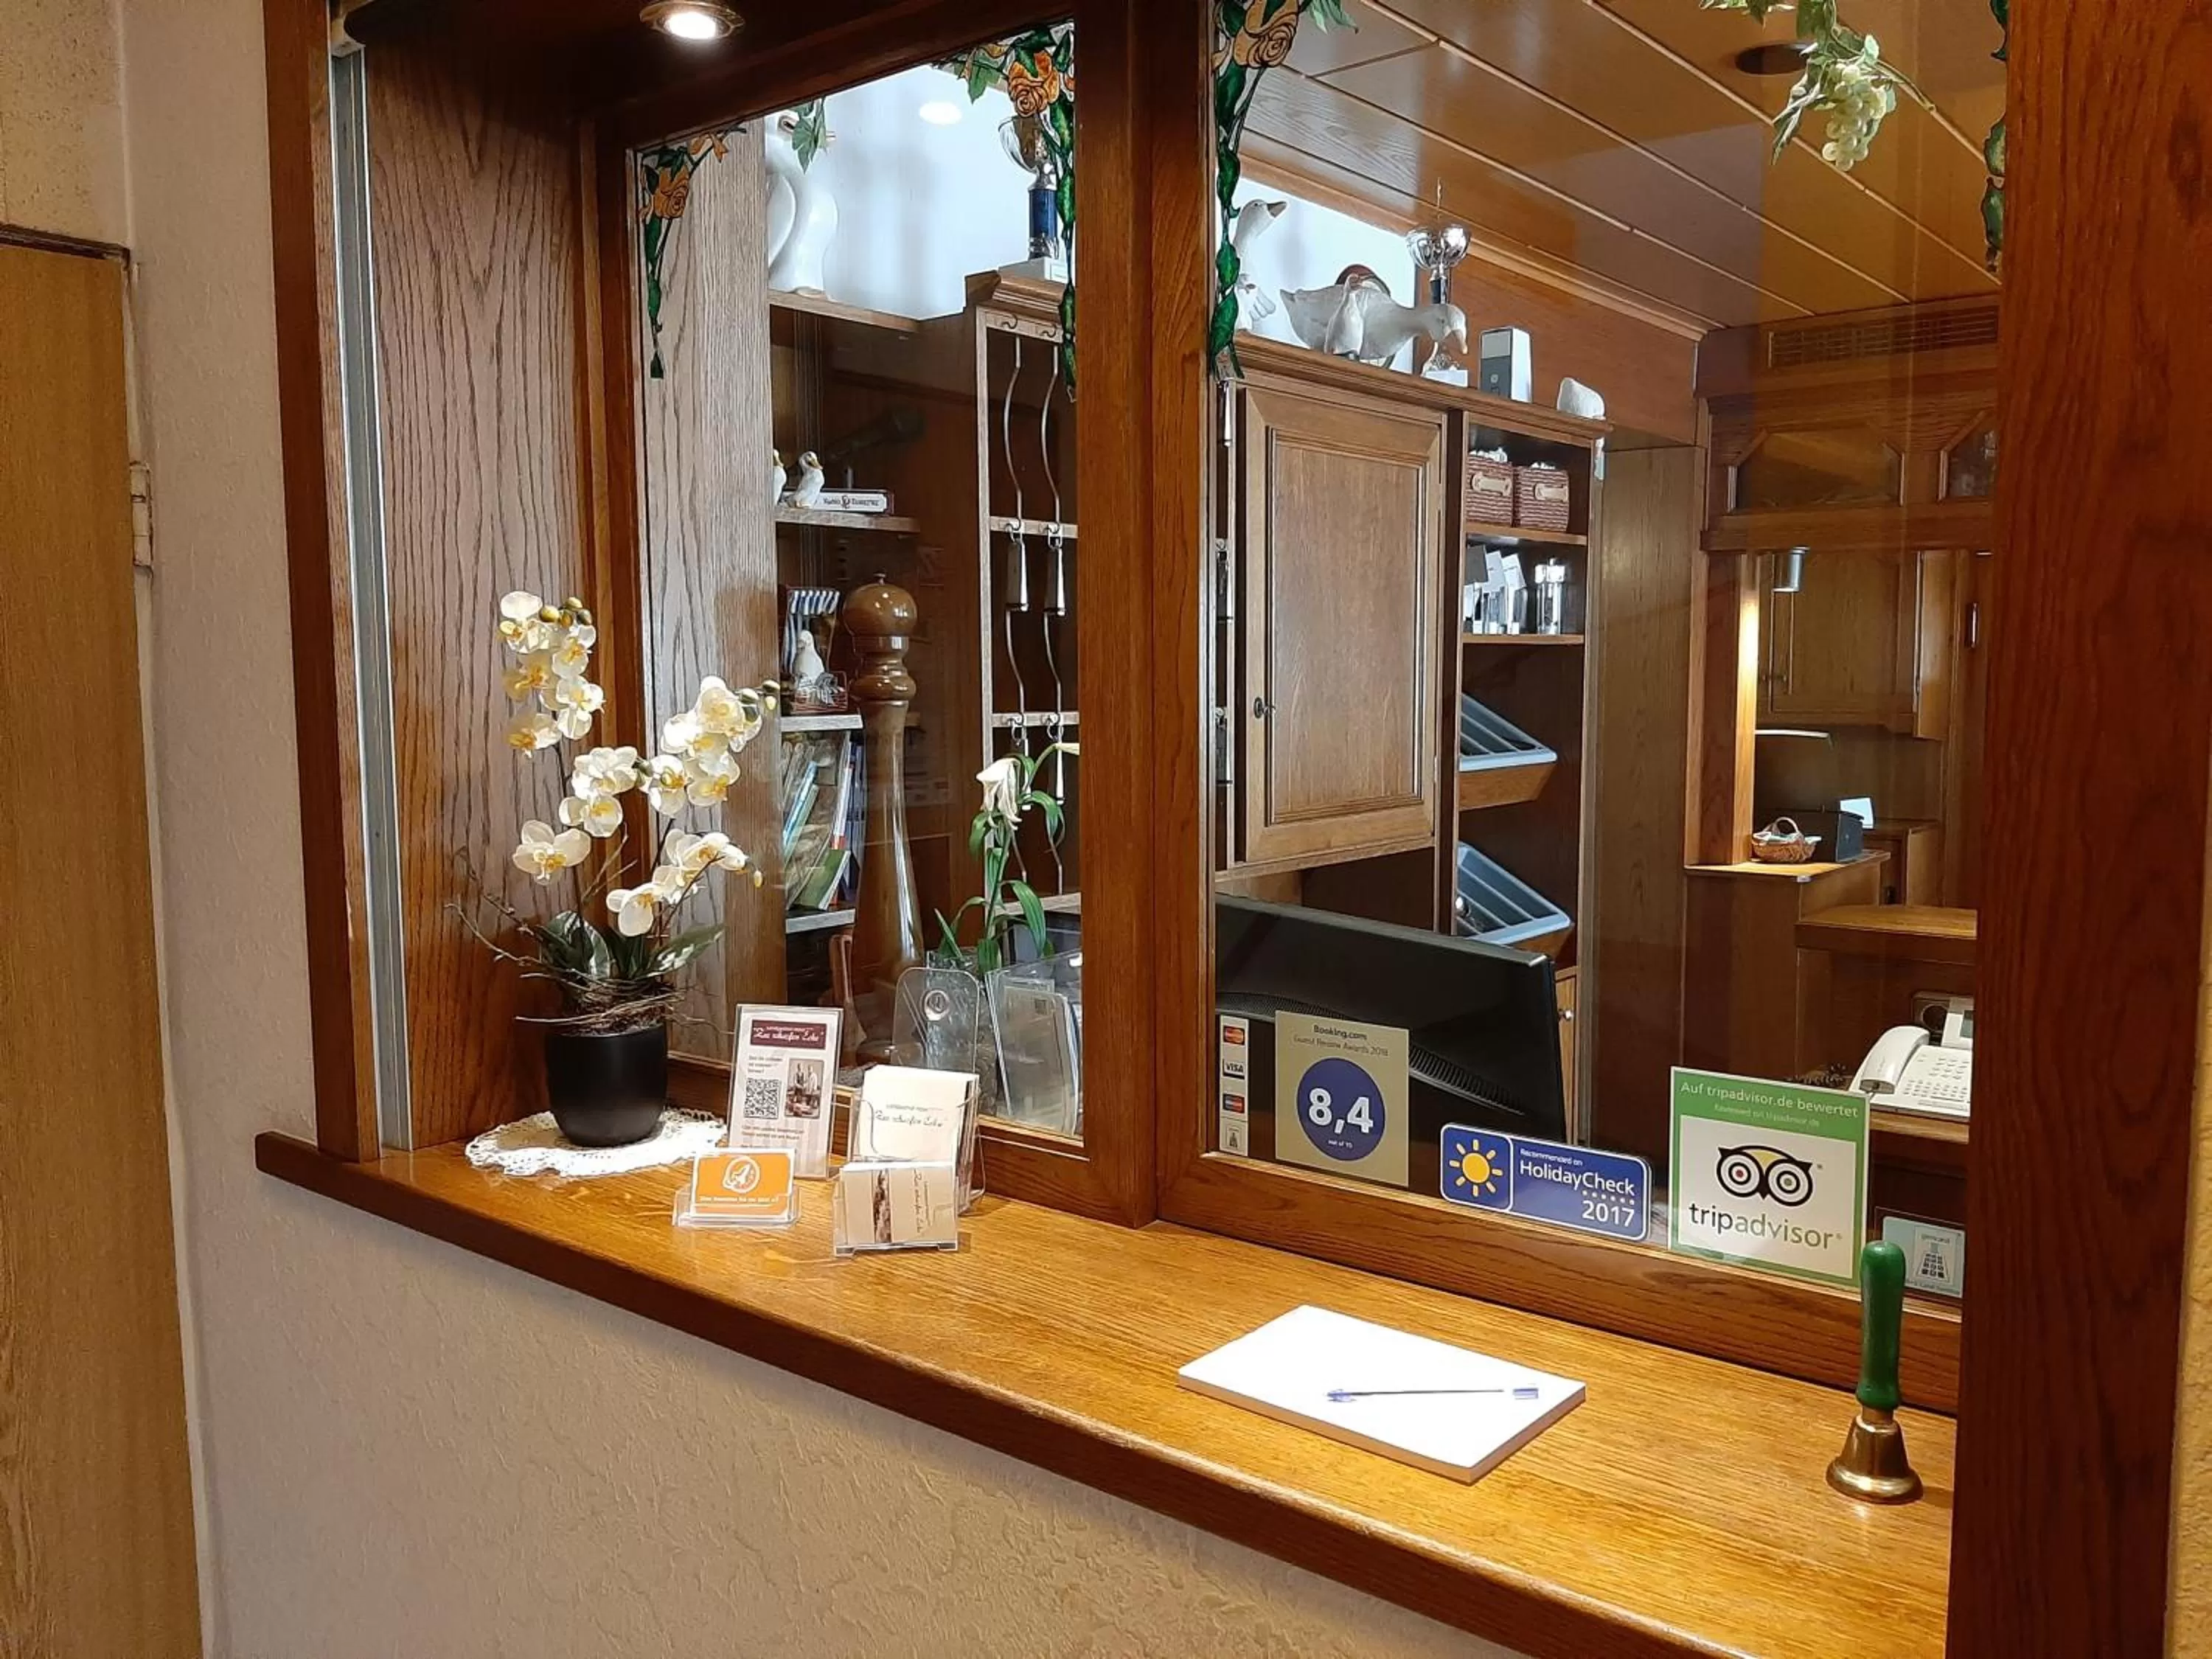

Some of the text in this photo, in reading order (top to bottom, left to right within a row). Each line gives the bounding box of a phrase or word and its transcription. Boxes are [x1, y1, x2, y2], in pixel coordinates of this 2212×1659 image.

[1313, 1024, 1367, 1040] Booking.com
[1226, 1062, 1244, 1073] VISA
[1309, 1088, 1374, 1134] 8,4
[1680, 1082, 1858, 1118] Auf tripadvisor.de bewertet
[1520, 1148, 1573, 1165] Recommended
[1520, 1160, 1635, 1196] HolidayCheck
[1582, 1200, 1635, 1228] 2017
[1688, 1203, 1833, 1249] tripadvisor
